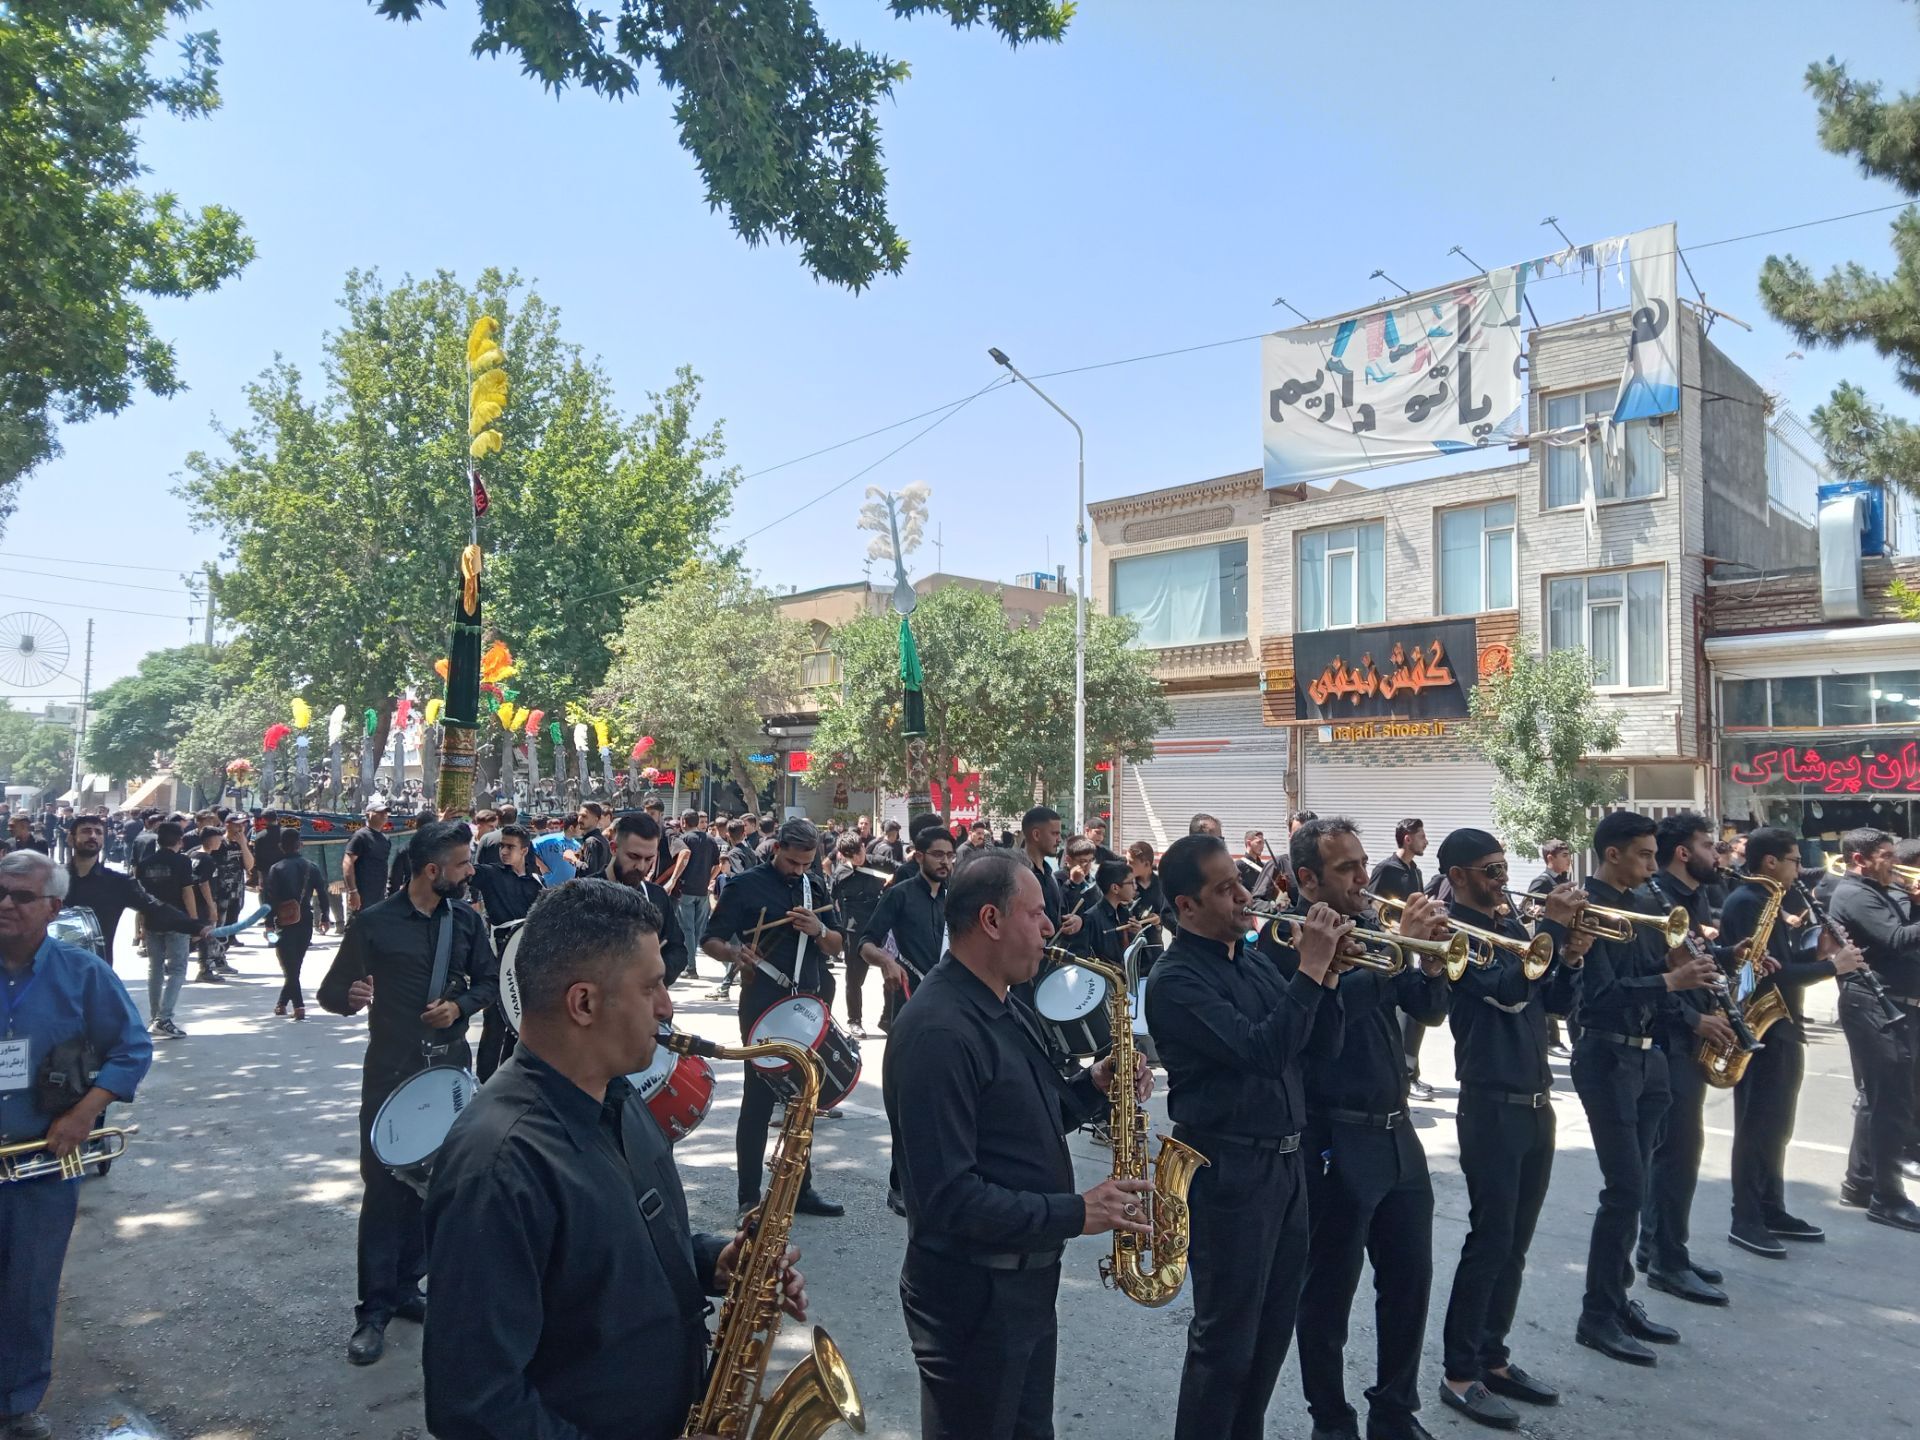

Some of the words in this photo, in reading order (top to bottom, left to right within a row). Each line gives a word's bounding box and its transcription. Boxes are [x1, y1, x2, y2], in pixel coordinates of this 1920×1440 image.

[1380, 638, 1456, 700] کفش
[1731, 747, 1863, 793] پوشاک
[506, 967, 521, 1019] YAMAHA
[1075, 977, 1096, 1011] YAMAHA
[451, 1084, 465, 1114] YAMAHA
